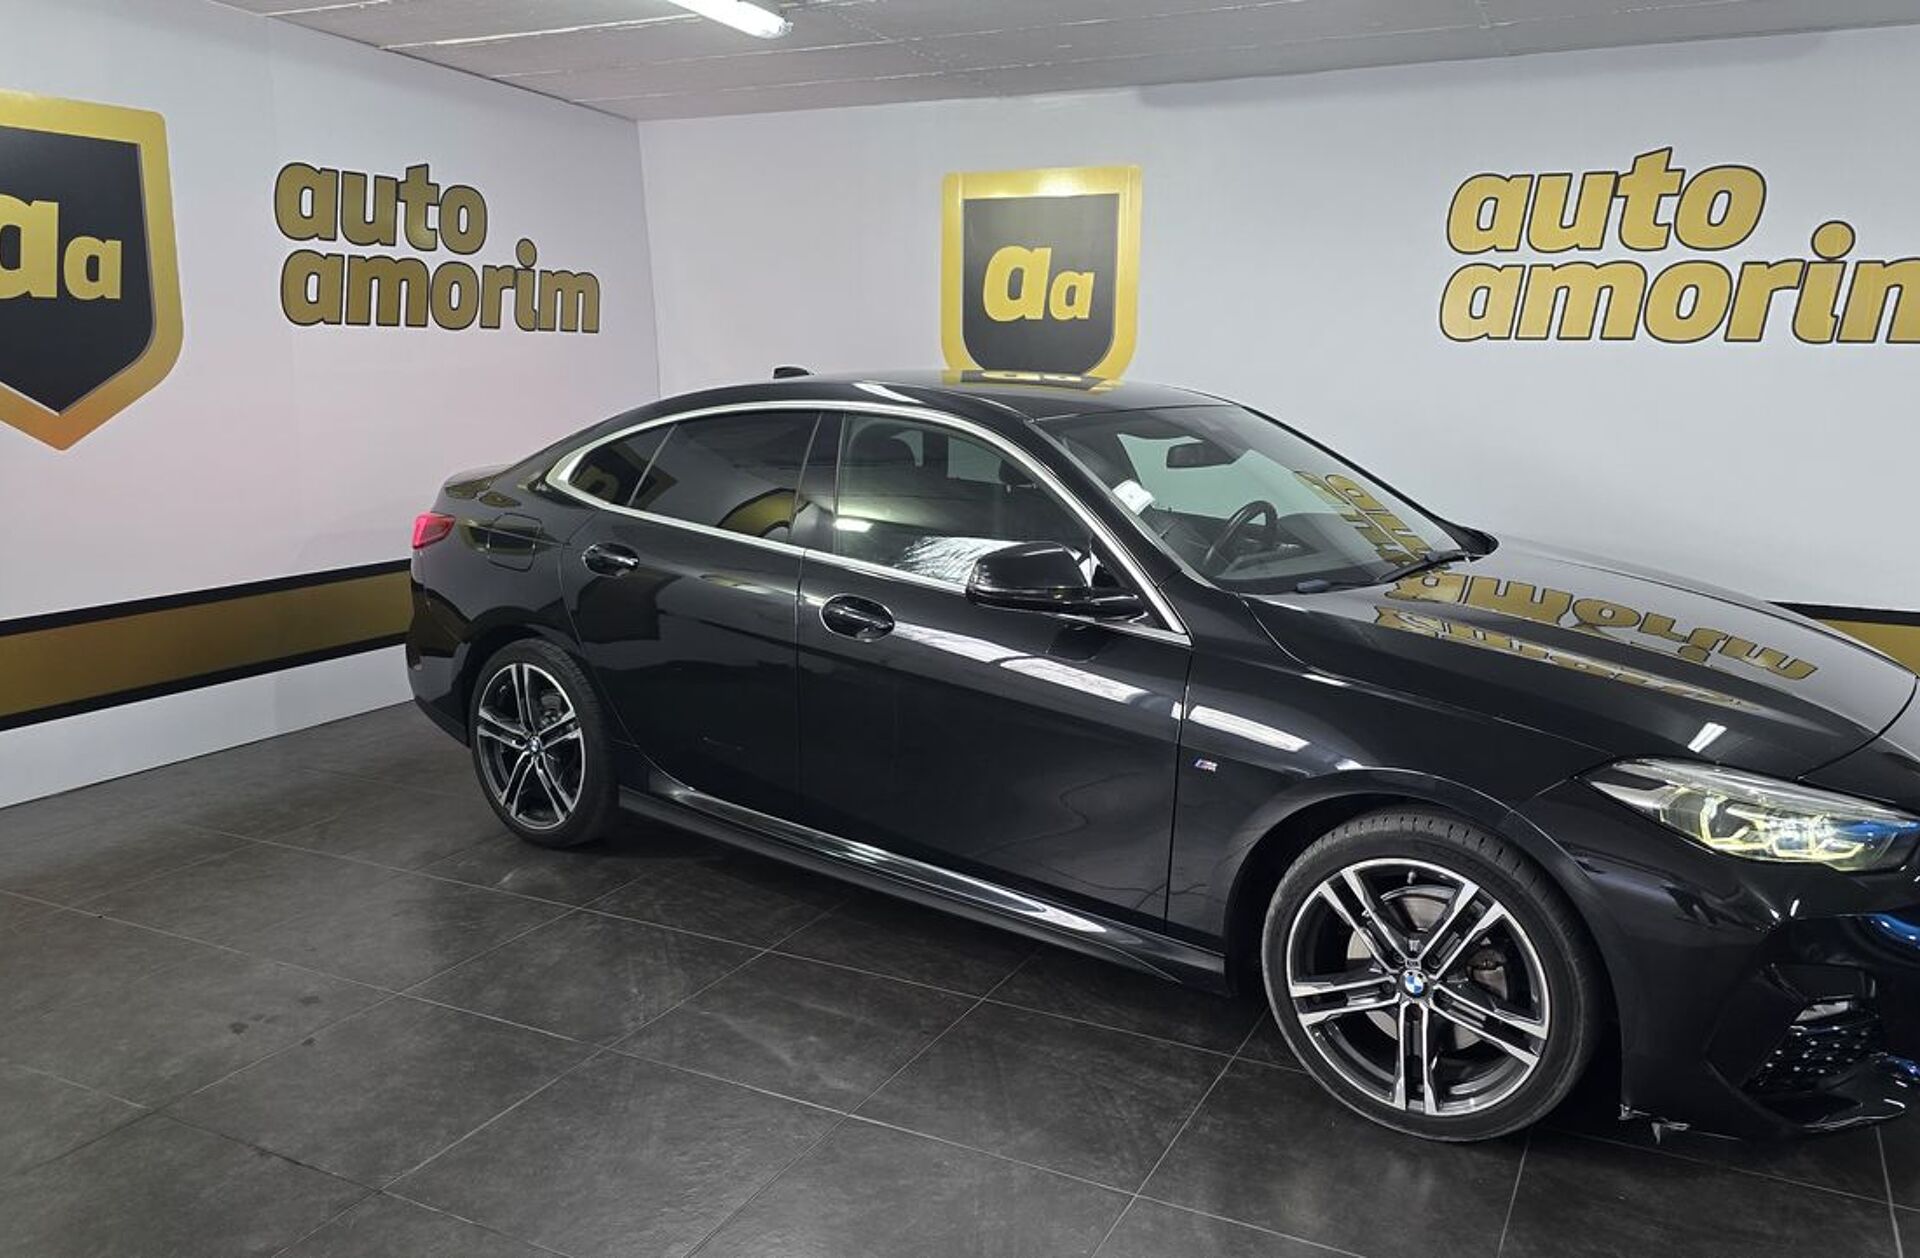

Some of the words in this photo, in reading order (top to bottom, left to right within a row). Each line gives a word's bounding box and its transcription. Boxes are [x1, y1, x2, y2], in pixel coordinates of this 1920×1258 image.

[274, 162, 487, 255] auto
[1446, 146, 1767, 255] auto
[280, 238, 600, 333] amorim
[983, 245, 1095, 322] aa
